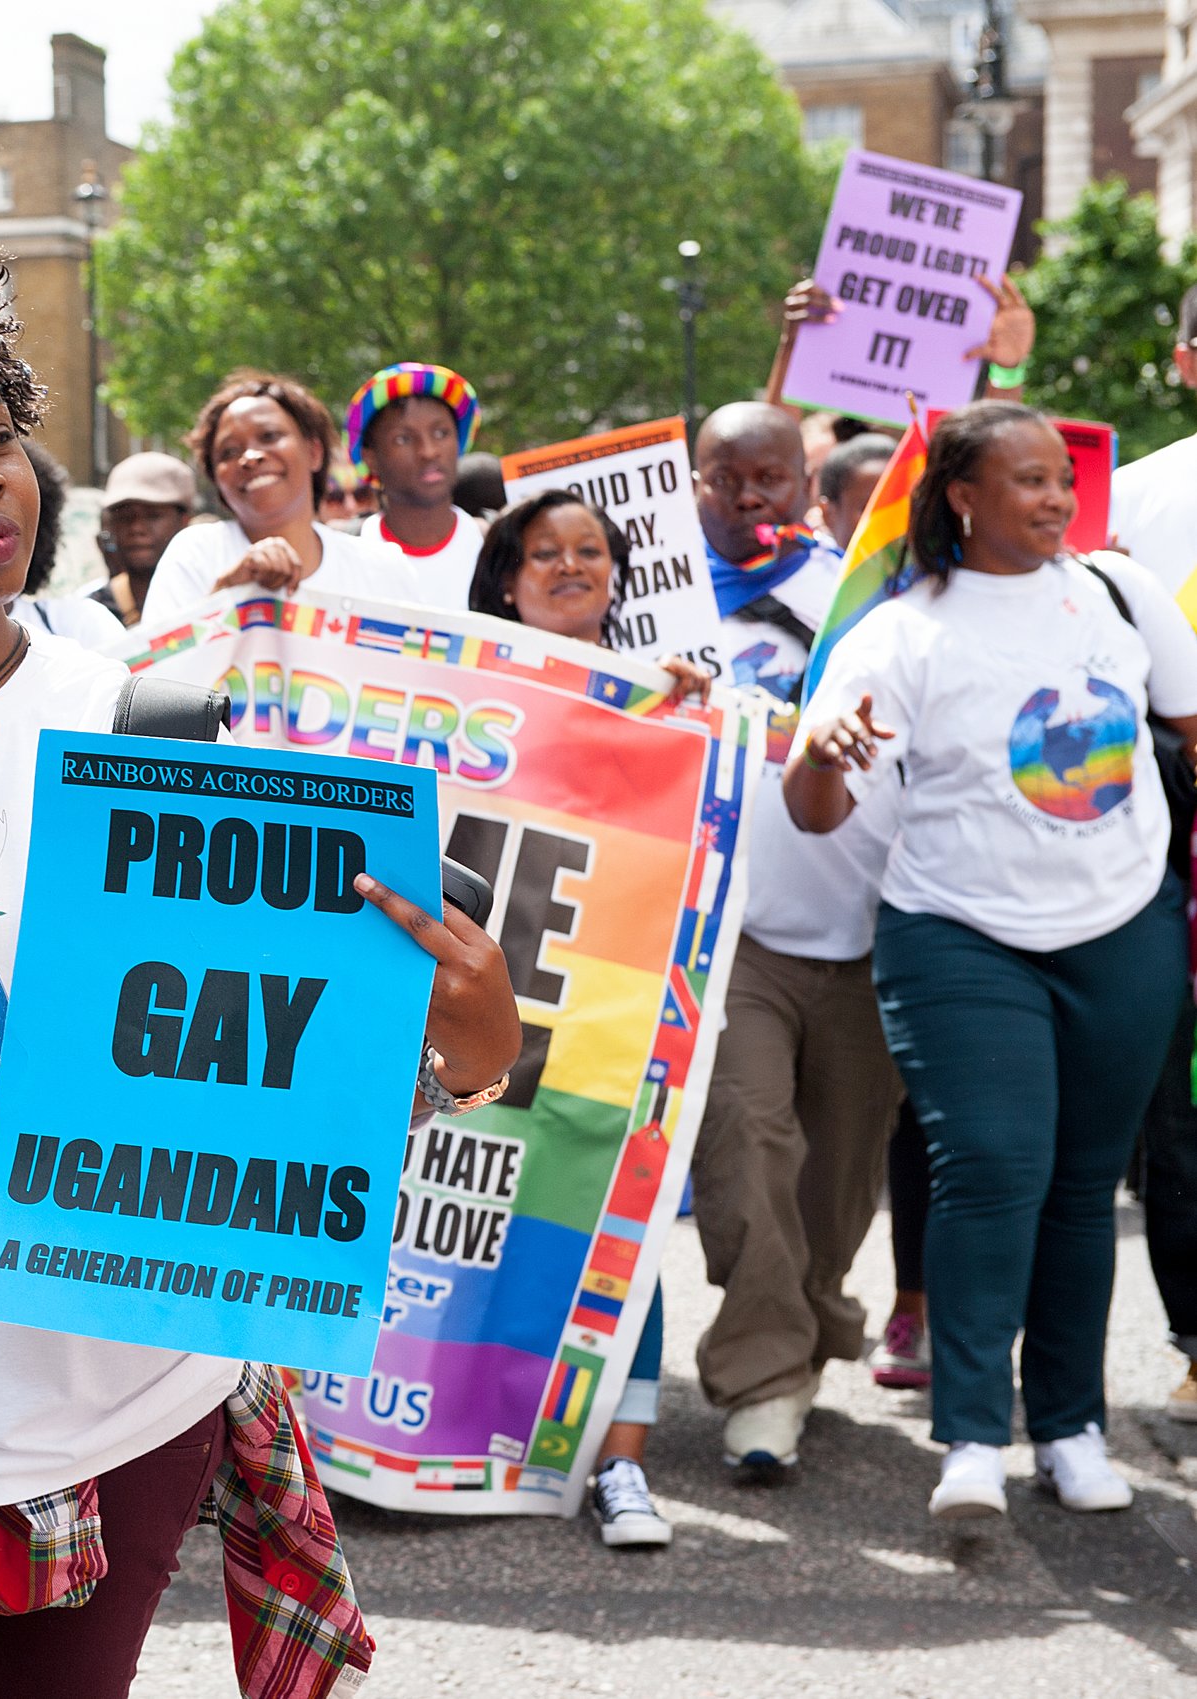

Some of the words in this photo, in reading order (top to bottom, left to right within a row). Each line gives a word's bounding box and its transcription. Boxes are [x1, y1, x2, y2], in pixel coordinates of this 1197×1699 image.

[889, 190, 964, 231] WE'RE
[837, 225, 917, 264] PROUD
[839, 272, 892, 309] GET
[895, 285, 969, 326] OVER
[638, 459, 677, 498] TO
[623, 554, 693, 600] DAN
[62, 758, 193, 788] RAINBOWS
[200, 770, 295, 799] ACROSS
[301, 780, 414, 812] BORDERS
[104, 808, 366, 915] PROUD
[111, 961, 329, 1090] GAY
[7, 1133, 370, 1243] UGANDANS
[421, 1128, 520, 1197] HATE
[414, 1197, 506, 1262] LOVE
[26, 1243, 218, 1299] GENERATION
[221, 1269, 263, 1304] OF
[264, 1275, 363, 1319] PRIDE
[370, 1377, 429, 1428] US
